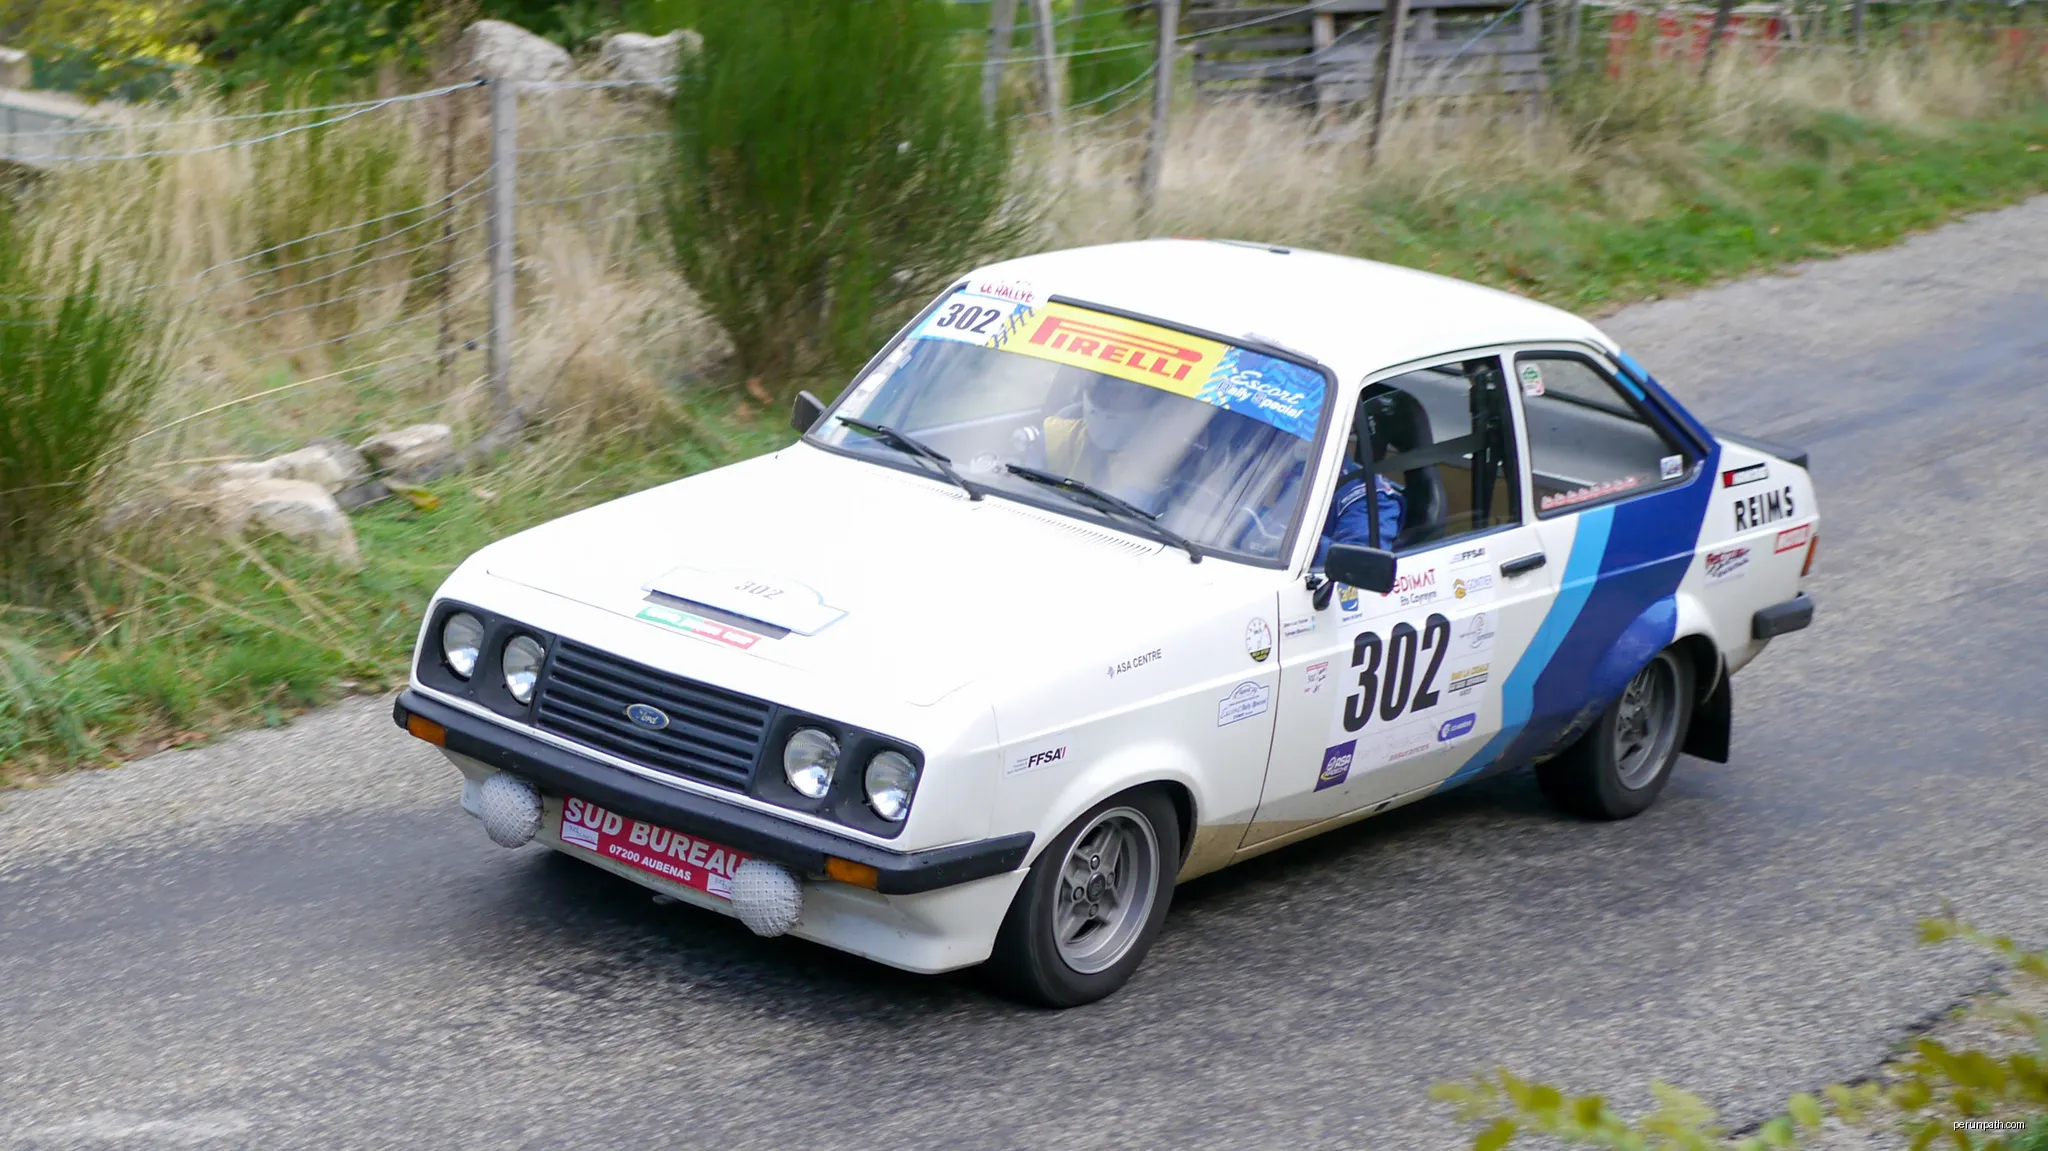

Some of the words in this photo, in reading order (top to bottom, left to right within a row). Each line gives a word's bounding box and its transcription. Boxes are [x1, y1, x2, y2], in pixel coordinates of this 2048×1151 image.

[936, 302, 1000, 335] 302
[1028, 315, 1203, 381] PIRELLI
[1230, 370, 1305, 405] Escort
[1734, 485, 1794, 532] REIMS
[733, 580, 784, 600] 302
[1116, 660, 1132, 675] ASA
[1132, 648, 1162, 668] CENTRE
[1343, 613, 1450, 733] 302
[635, 709, 659, 725] Ford
[1027, 748, 1063, 768] FFSA
[565, 797, 623, 836] SUD
[629, 822, 748, 877] BUREAU
[609, 844, 640, 864] 07200
[641, 856, 692, 881] AUBENAS
